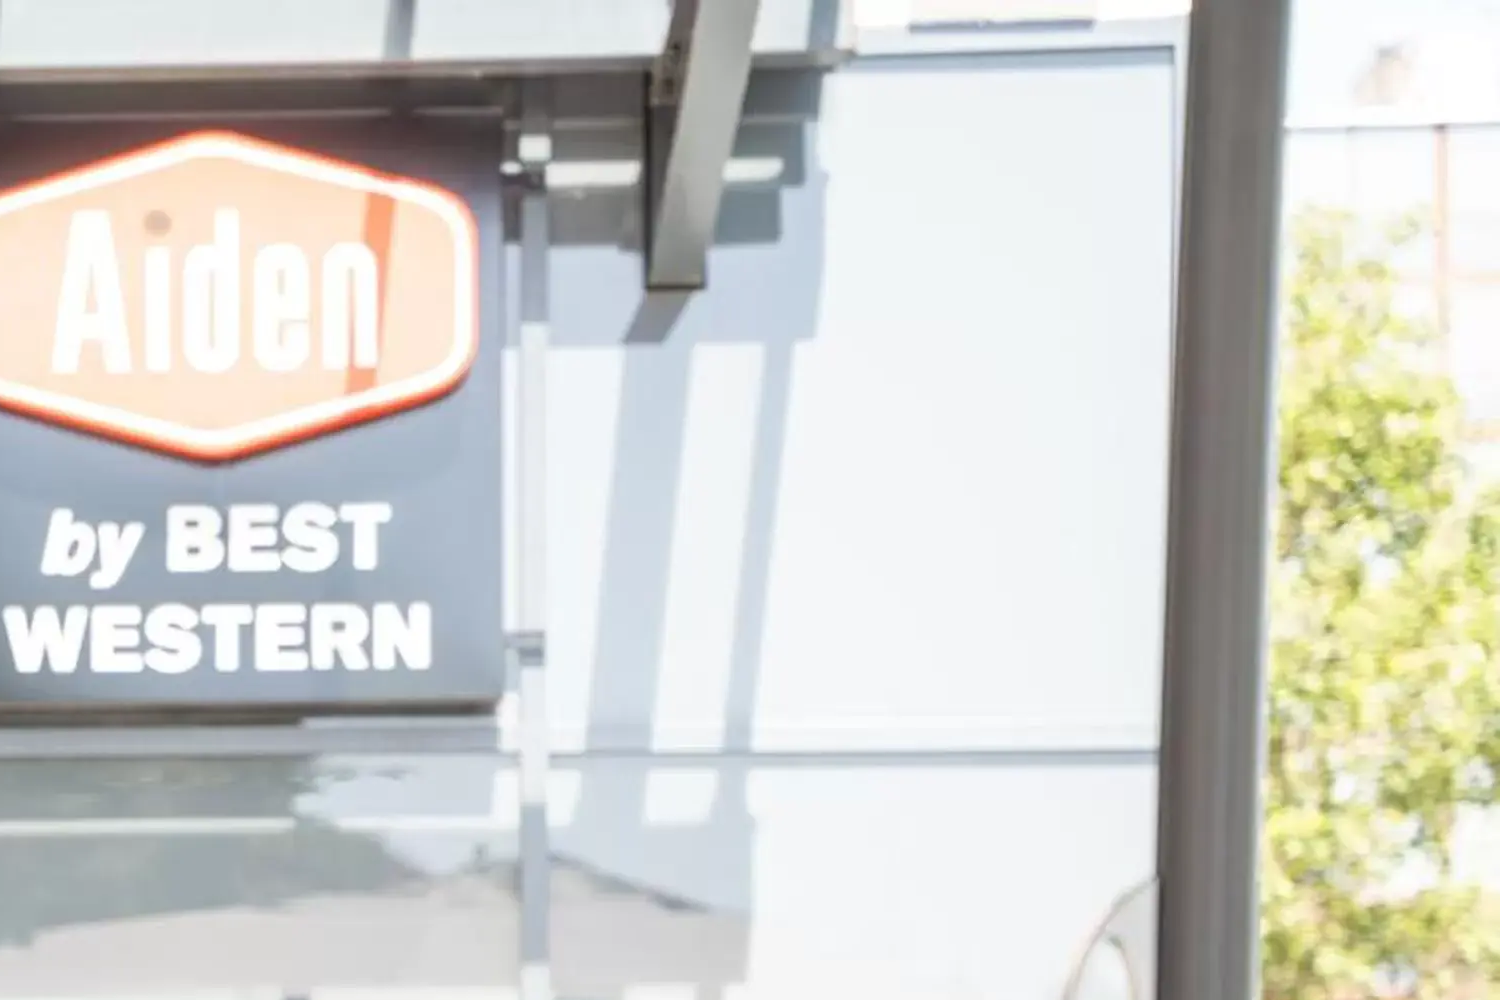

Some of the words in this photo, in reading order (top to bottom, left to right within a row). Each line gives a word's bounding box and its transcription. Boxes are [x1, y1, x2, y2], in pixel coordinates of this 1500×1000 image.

[53, 208, 379, 372] Aiden
[40, 508, 145, 589] by
[166, 502, 393, 573] BEST
[2, 602, 432, 674] WESTERN
